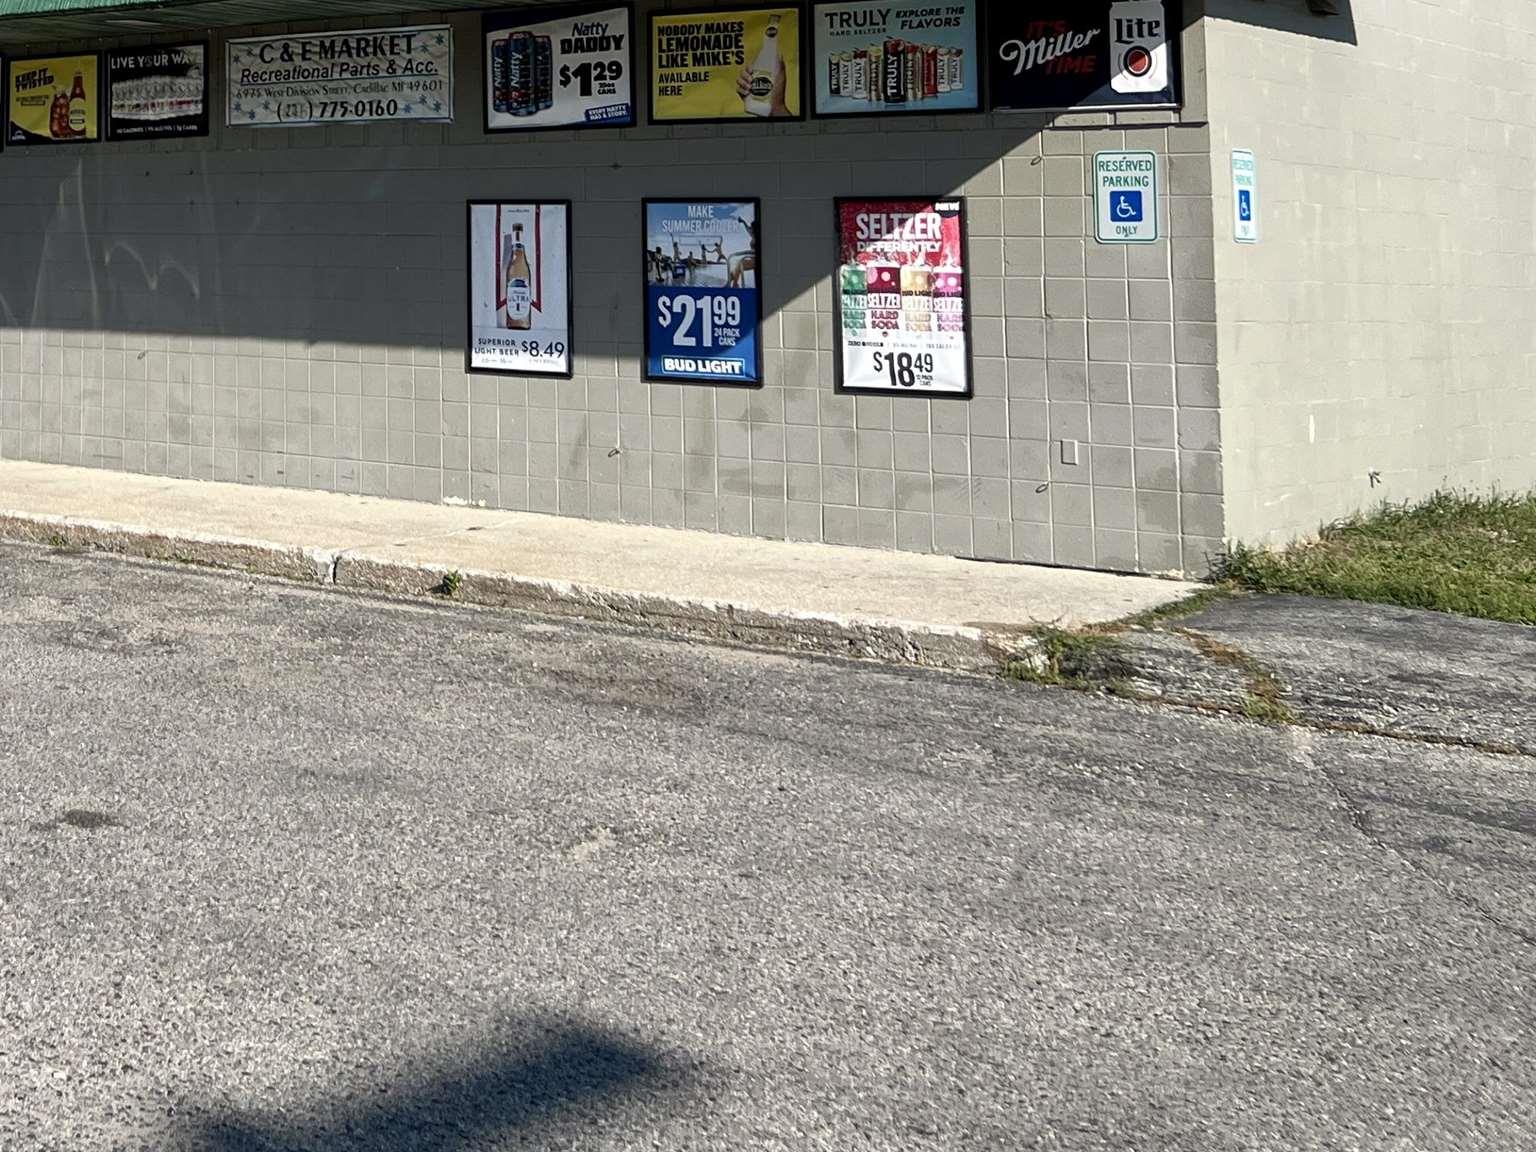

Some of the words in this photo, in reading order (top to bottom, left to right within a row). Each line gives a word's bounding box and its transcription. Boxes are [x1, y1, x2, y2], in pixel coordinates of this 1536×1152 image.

[824, 8, 891, 29] TRULY
[895, 8, 940, 18] EXPLORE
[945, 6, 965, 15] THE
[572, 22, 608, 37] Natty
[658, 24, 702, 36] NOBODY
[704, 21, 744, 34] MAKES
[900, 17, 961, 30] FLAVORS
[1114, 18, 1161, 44] Lite
[259, 44, 275, 64] C
[280, 42, 294, 62] &
[301, 41, 312, 61] E
[319, 34, 417, 59] MARKET
[560, 34, 624, 54] DADDY
[658, 33, 744, 52] LEMONADE
[658, 53, 689, 68] LIKE
[692, 50, 744, 67] MIKE'S
[999, 28, 1101, 76] Miller
[111, 56, 135, 70] LIVE
[137, 53, 169, 68] YOUR
[16, 70, 37, 84] KEEP
[240, 63, 334, 83] Recreational
[339, 61, 380, 77] Parts
[386, 59, 397, 74] &
[402, 58, 438, 74] Acc.
[494, 56, 503, 87] Natty
[511, 51, 522, 88] Natty
[854, 61, 862, 91] TRULY
[886, 55, 898, 96] TRULY
[16, 75, 54, 92] TWISTED
[658, 71, 710, 84] AVAILABLE
[658, 85, 683, 96] HERE
[1098, 160, 1152, 172] RESERVED
[1102, 176, 1149, 187] PARKING
[688, 205, 714, 218] MAKE
[662, 219, 702, 233] SUMMER
[855, 213, 942, 240] SELTZER
[1115, 226, 1138, 235] ONLY
[871, 310, 899, 319] HARD
[871, 320, 899, 329] SODA
[714, 328, 722, 337] 24
[723, 328, 740, 337] PACK
[478, 338, 516, 346] SUPERIOR
[719, 337, 736, 346] CANS
[499, 348, 519, 356] BEER
[521, 340, 565, 359] $8.49
[664, 358, 697, 372] BUD
[698, 359, 743, 374] LIGHT
